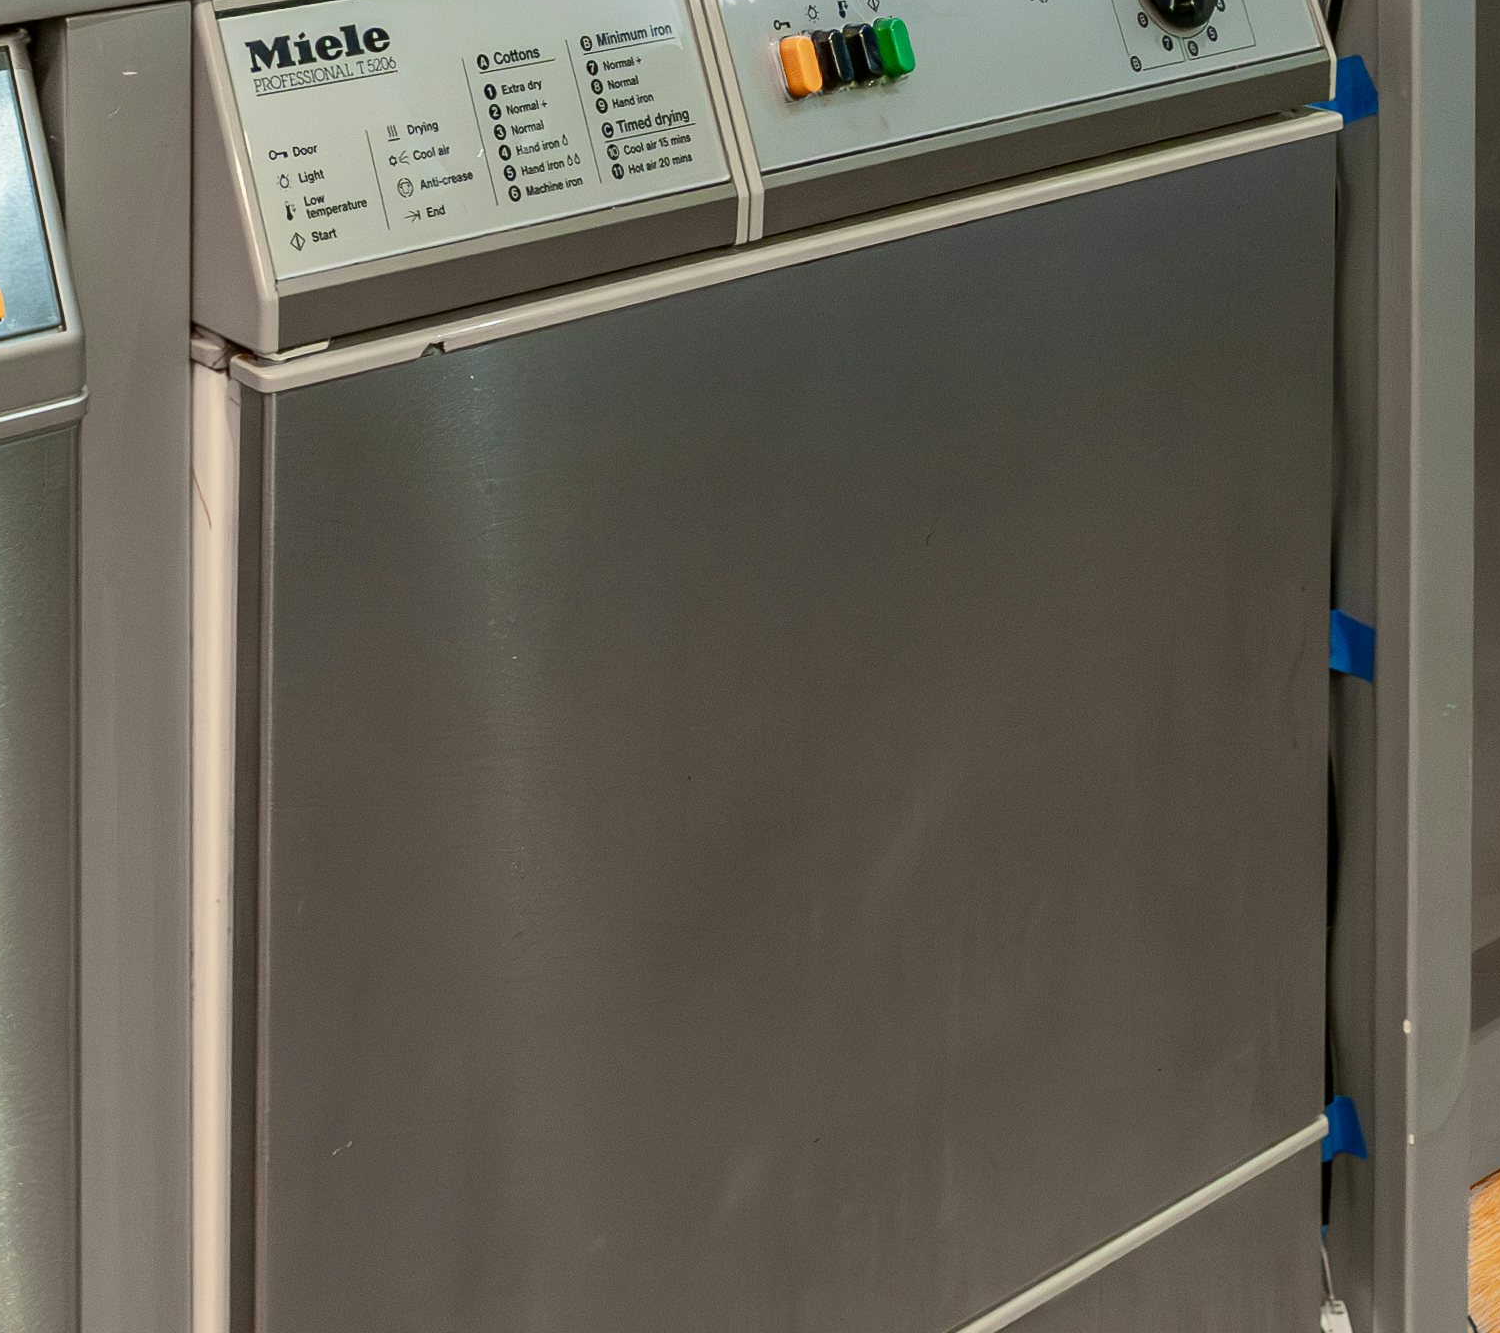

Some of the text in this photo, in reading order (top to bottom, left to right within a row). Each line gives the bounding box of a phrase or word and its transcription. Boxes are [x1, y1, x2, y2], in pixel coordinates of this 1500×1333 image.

[596, 29, 648, 47] Minimum
[649, 24, 672, 37] iron
[244, 24, 391, 73] Miele
[493, 48, 541, 65] Cottons
[602, 56, 635, 71] Normal
[253, 56, 397, 93] PROFESSIONAL T 5206
[607, 75, 640, 90] Normal
[501, 83, 526, 95] Extra
[528, 80, 542, 90] dry
[506, 100, 540, 115] Normal
[541, 100, 548, 109] +
[612, 95, 635, 109] Hand
[636, 93, 655, 104] iron
[406, 121, 440, 136] Drying
[511, 120, 545, 136] Normal
[616, 115, 651, 133] Timed
[655, 109, 690, 127] drying
[292, 144, 318, 158] Door
[412, 144, 450, 161] Cool air
[515, 141, 541, 156] Hand
[542, 139, 560, 151] iron
[623, 142, 645, 156] Cool
[646, 141, 657, 150] air
[658, 137, 669, 148] 15
[670, 133, 692, 145] mins
[521, 162, 545, 176] Hand
[547, 158, 565, 171] iron
[628, 162, 644, 175] Hot
[646, 160, 657, 170] air
[658, 157, 670, 168] 20
[672, 153, 693, 165] mins
[297, 169, 325, 184] Light
[420, 171, 474, 191] Anti-crease
[525, 181, 564, 197] Machine
[565, 177, 584, 189] iron
[303, 194, 325, 207] Low
[306, 198, 367, 220] temperature
[426, 205, 446, 218] End
[311, 228, 338, 243] Start
